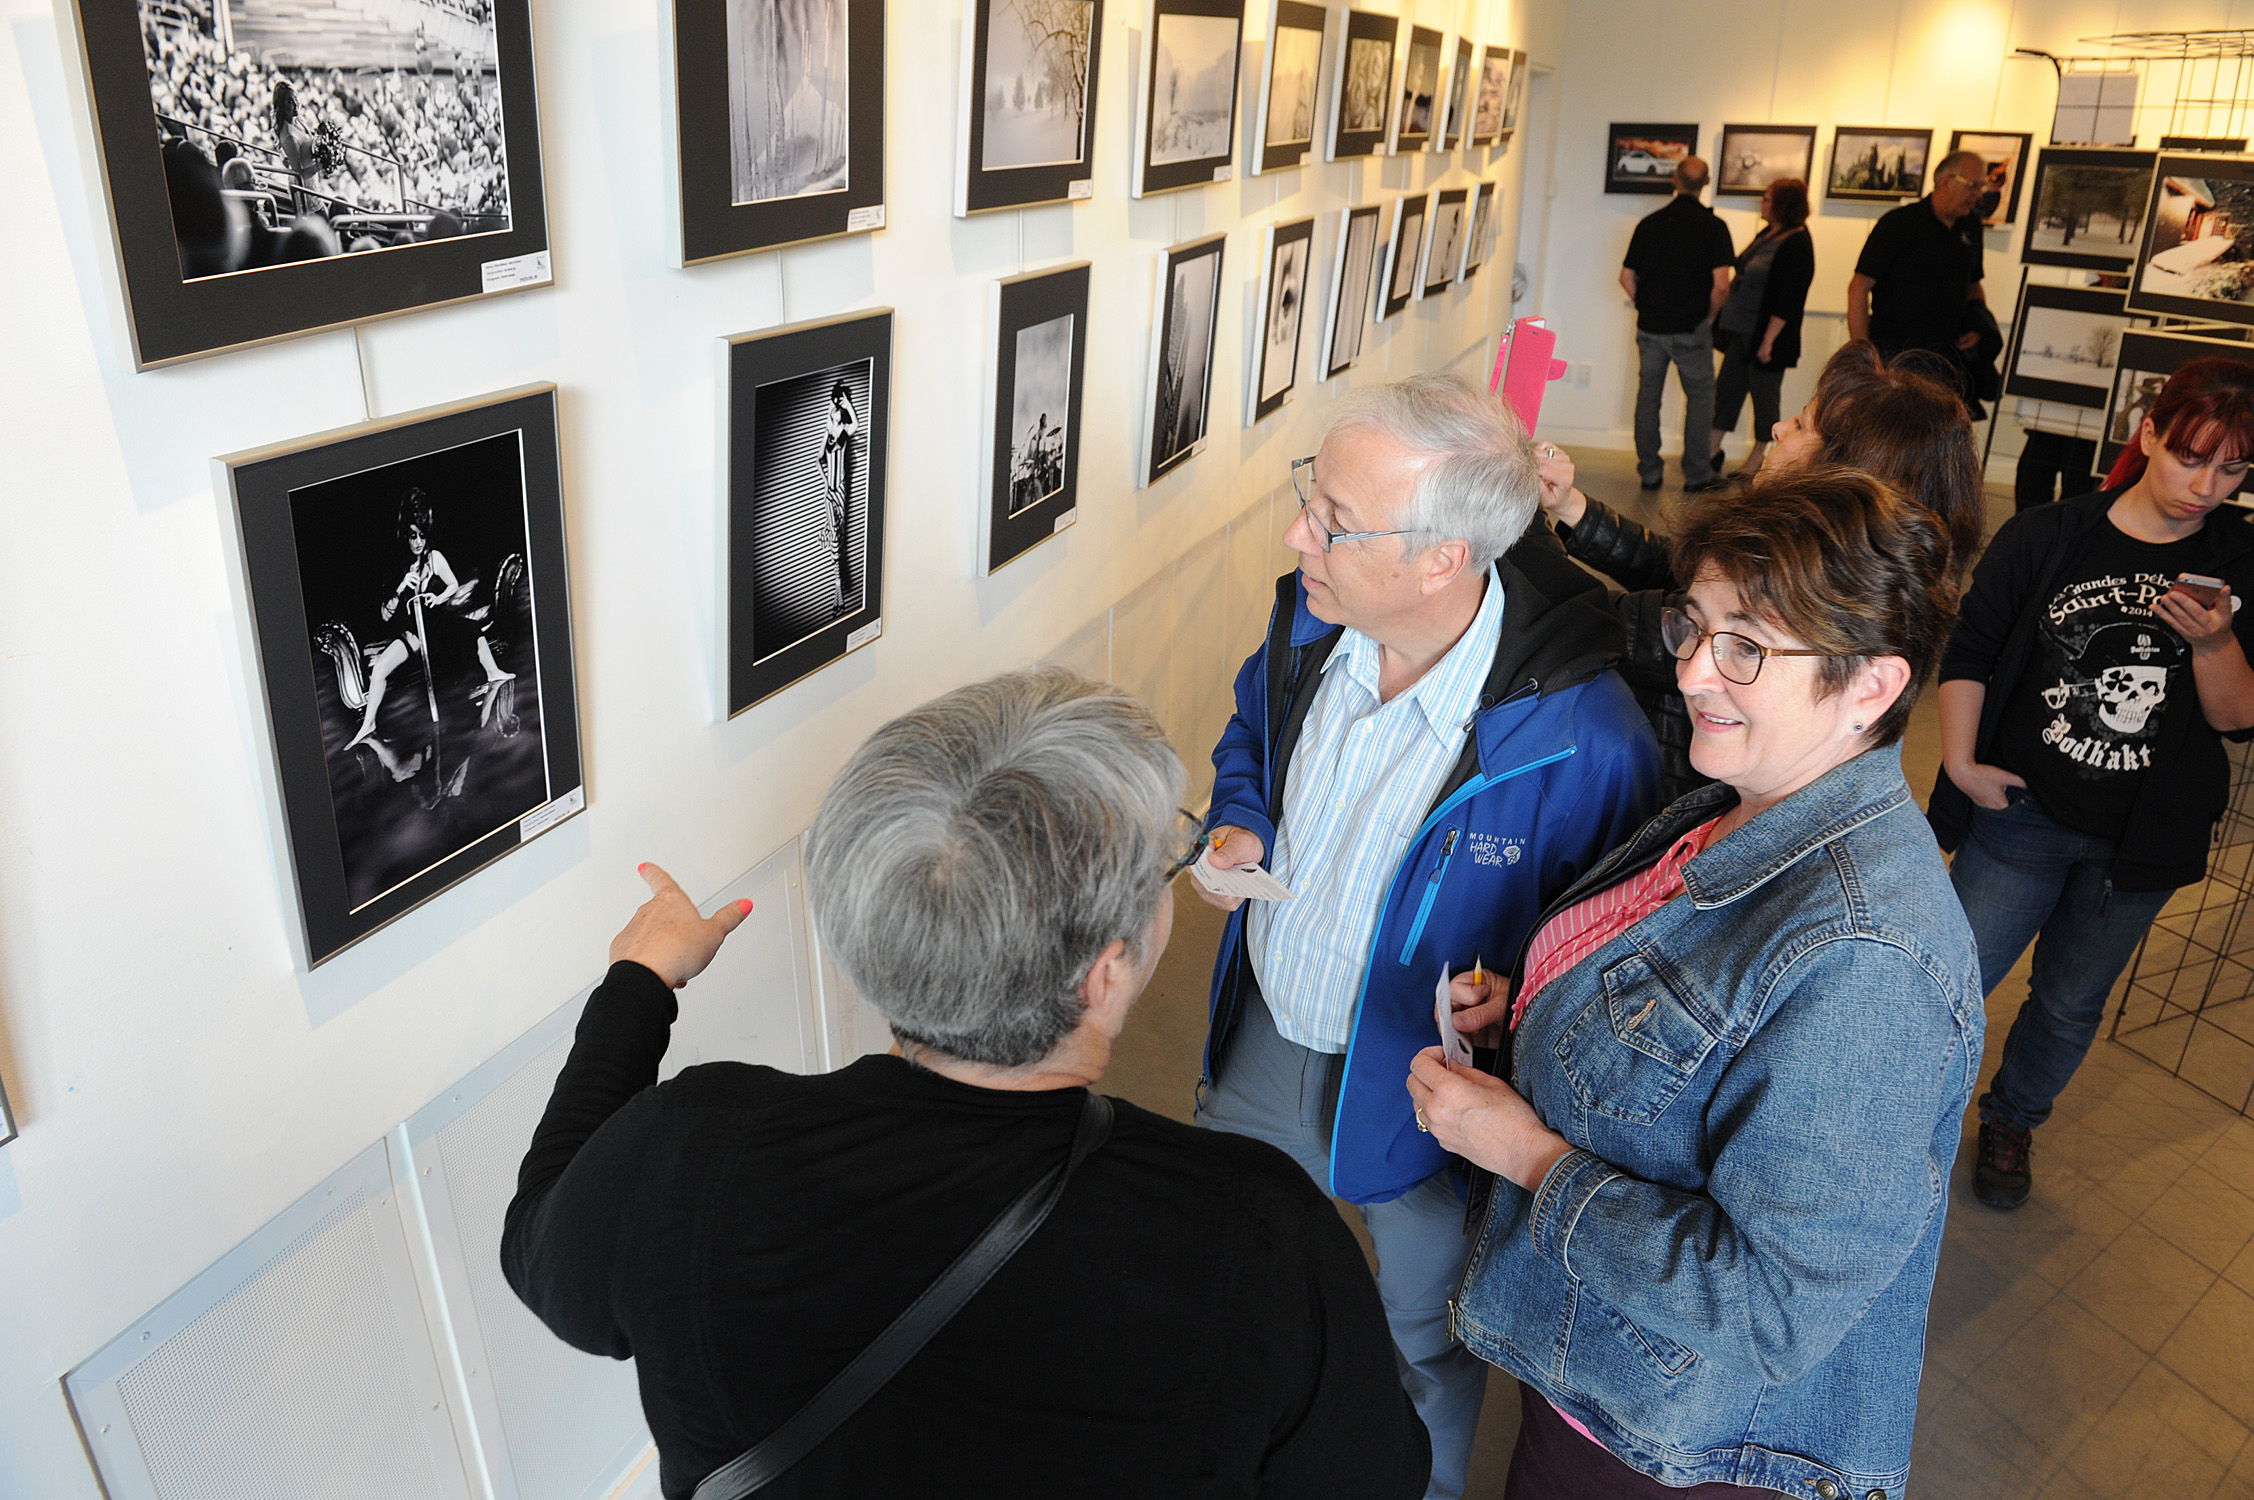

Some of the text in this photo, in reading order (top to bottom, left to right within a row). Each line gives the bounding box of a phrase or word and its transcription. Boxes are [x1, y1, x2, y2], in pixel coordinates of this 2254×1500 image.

[2128, 606, 2154, 618] 2014
[1469, 832, 1526, 845] MOUNTAIN
[1469, 841, 1497, 855] HARD
[1474, 853, 1503, 867] WEAR
